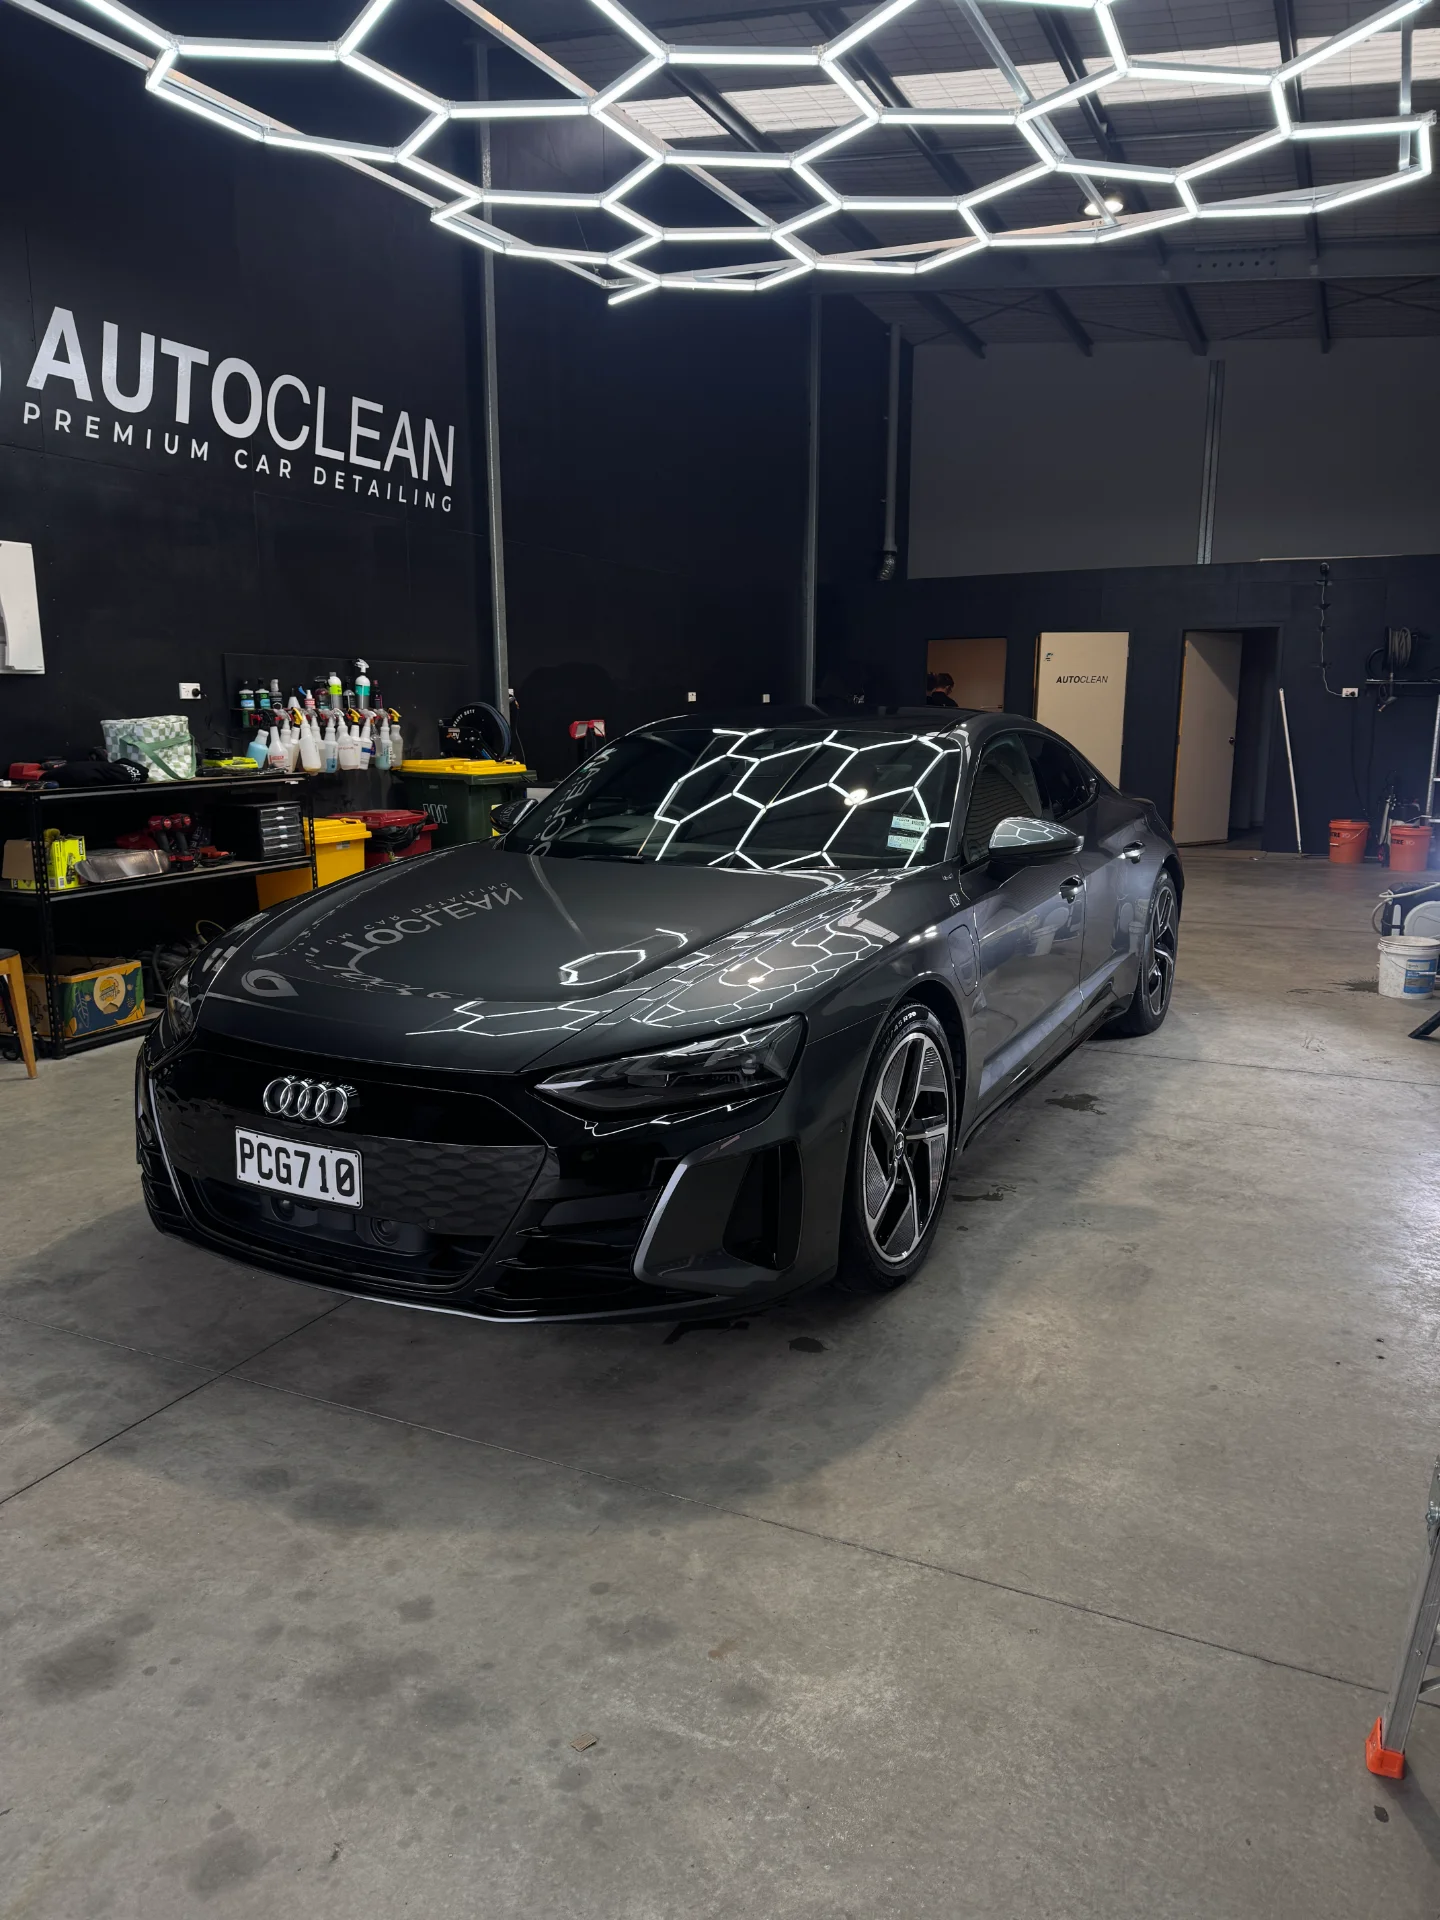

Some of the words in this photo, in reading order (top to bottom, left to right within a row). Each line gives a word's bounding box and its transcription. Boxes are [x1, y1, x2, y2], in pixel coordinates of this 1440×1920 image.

[26, 306, 455, 486] AUTOCLEAN
[23, 401, 209, 461] PREMIUM
[234, 449, 292, 479] CAR
[314, 466, 453, 513] DETAILING
[1056, 675, 1108, 684] AUTOCLEAN
[239, 1136, 355, 1197] PCG710
